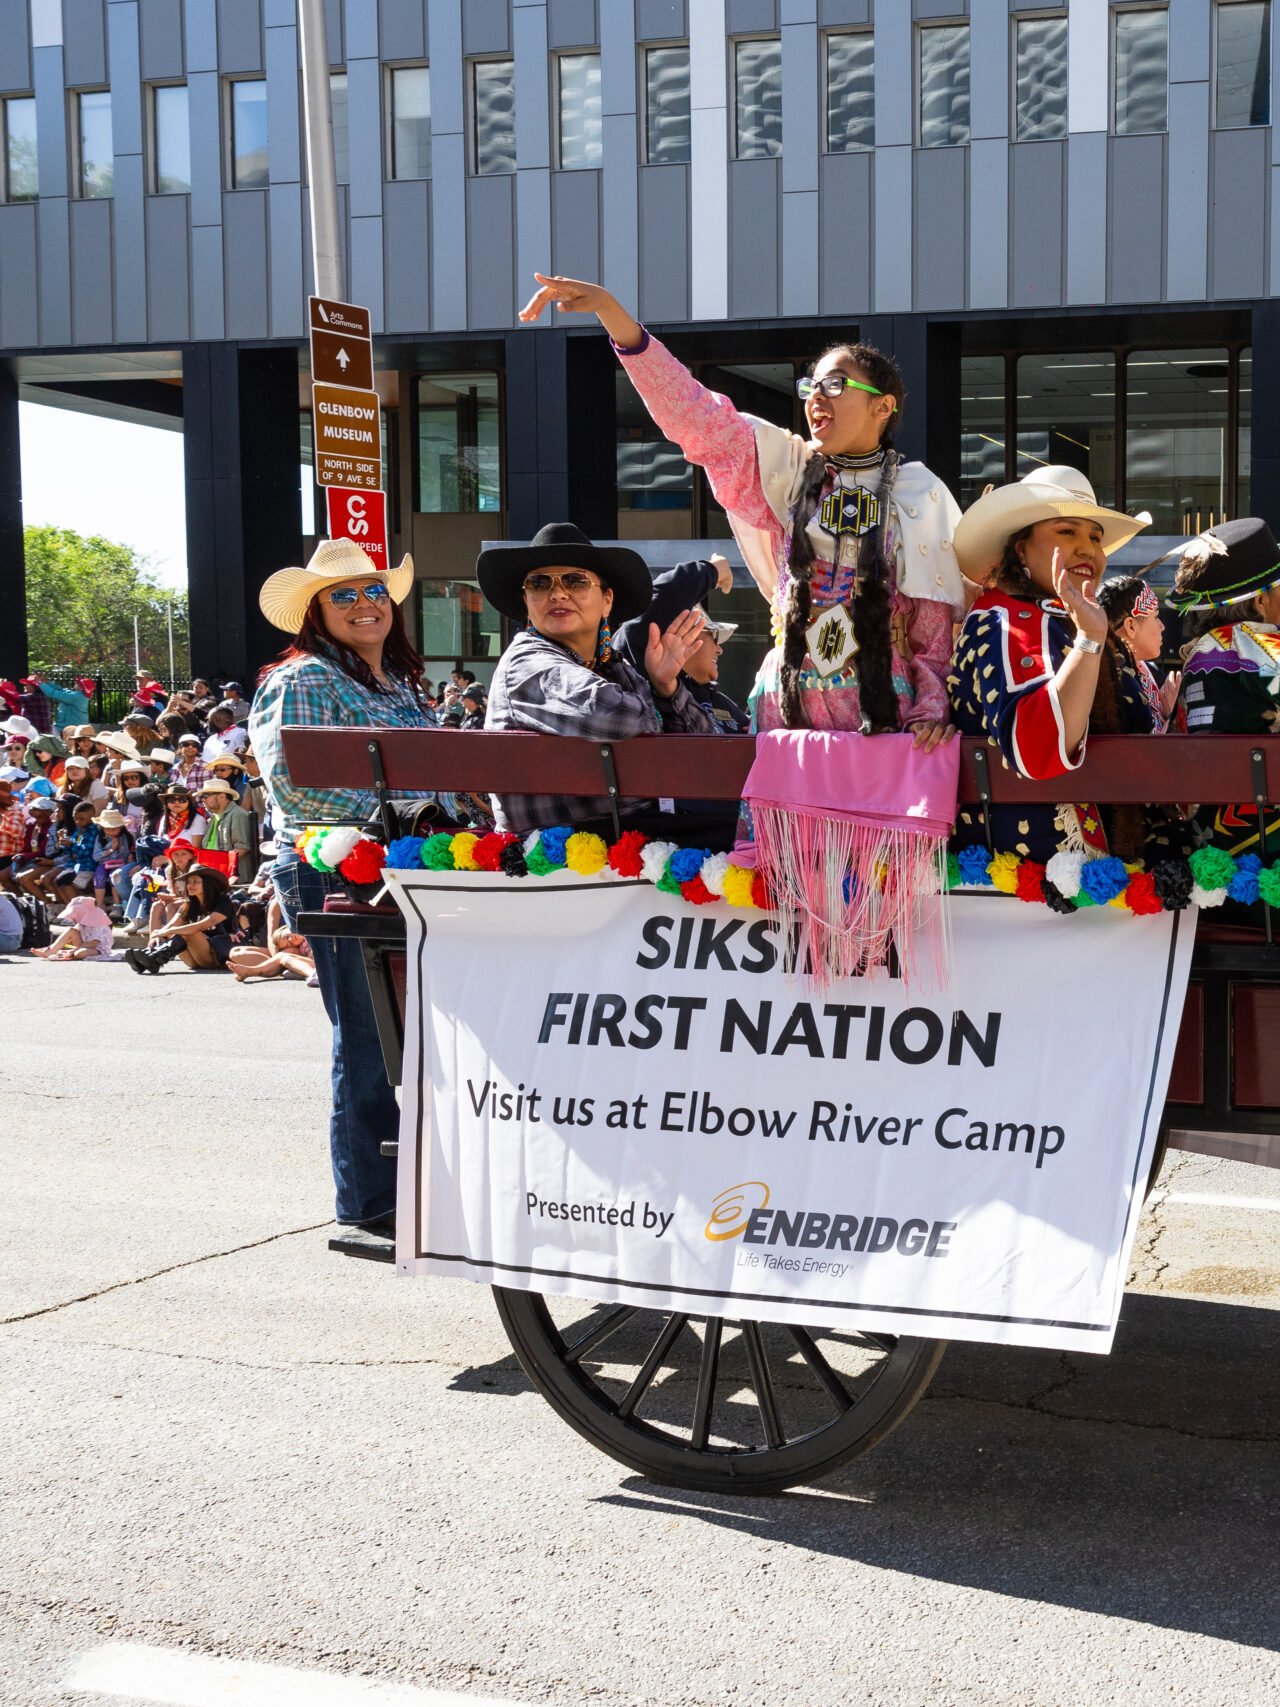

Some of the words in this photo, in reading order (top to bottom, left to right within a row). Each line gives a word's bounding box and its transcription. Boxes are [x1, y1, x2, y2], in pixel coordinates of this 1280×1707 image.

[330, 312, 344, 320] Arts
[330, 317, 363, 330] Commons
[318, 401, 375, 420] GLENBOW
[323, 425, 373, 443] MUSEUM
[324, 459, 353, 471] NORTH
[356, 463, 375, 473] SIDE
[322, 471, 334, 480] OF
[337, 473, 343, 481] 9
[346, 474, 362, 484] AVE
[366, 476, 376, 486] SE
[357, 541, 383, 553] PEDE
[538, 992, 708, 1051] FIRST
[719, 997, 1002, 1068] NATION
[466, 1079, 542, 1123] Visit
[552, 1096, 596, 1127] us
[605, 1094, 649, 1130] at
[659, 1090, 798, 1139] Elbow
[808, 1100, 924, 1146] River
[934, 1107, 1066, 1169] Camp
[526, 1192, 635, 1228] Presented
[643, 1201, 675, 1238] by
[742, 1207, 958, 1259] ENBRIDGE
[736, 1251, 759, 1268] Life
[762, 1253, 801, 1272] Takes
[801, 1256, 850, 1278] Energy
